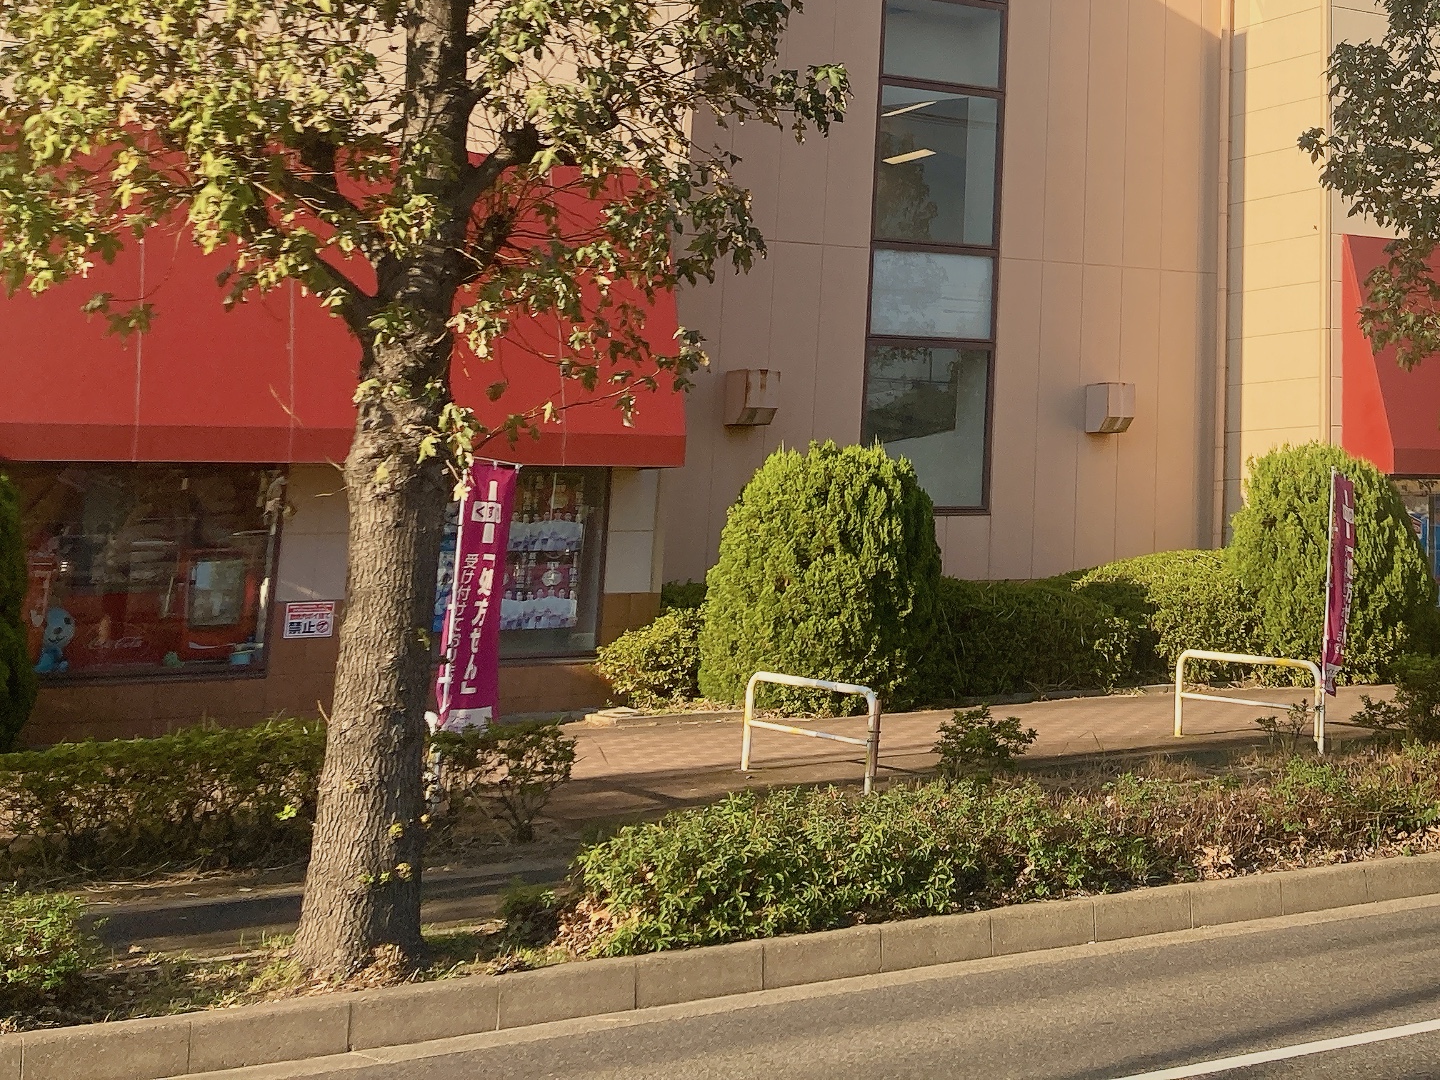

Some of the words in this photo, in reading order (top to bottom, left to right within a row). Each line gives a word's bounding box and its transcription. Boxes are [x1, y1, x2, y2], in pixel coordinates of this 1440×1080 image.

[289, 621, 316, 634] 禁止
[448, 553, 480, 685] 受け付けており
